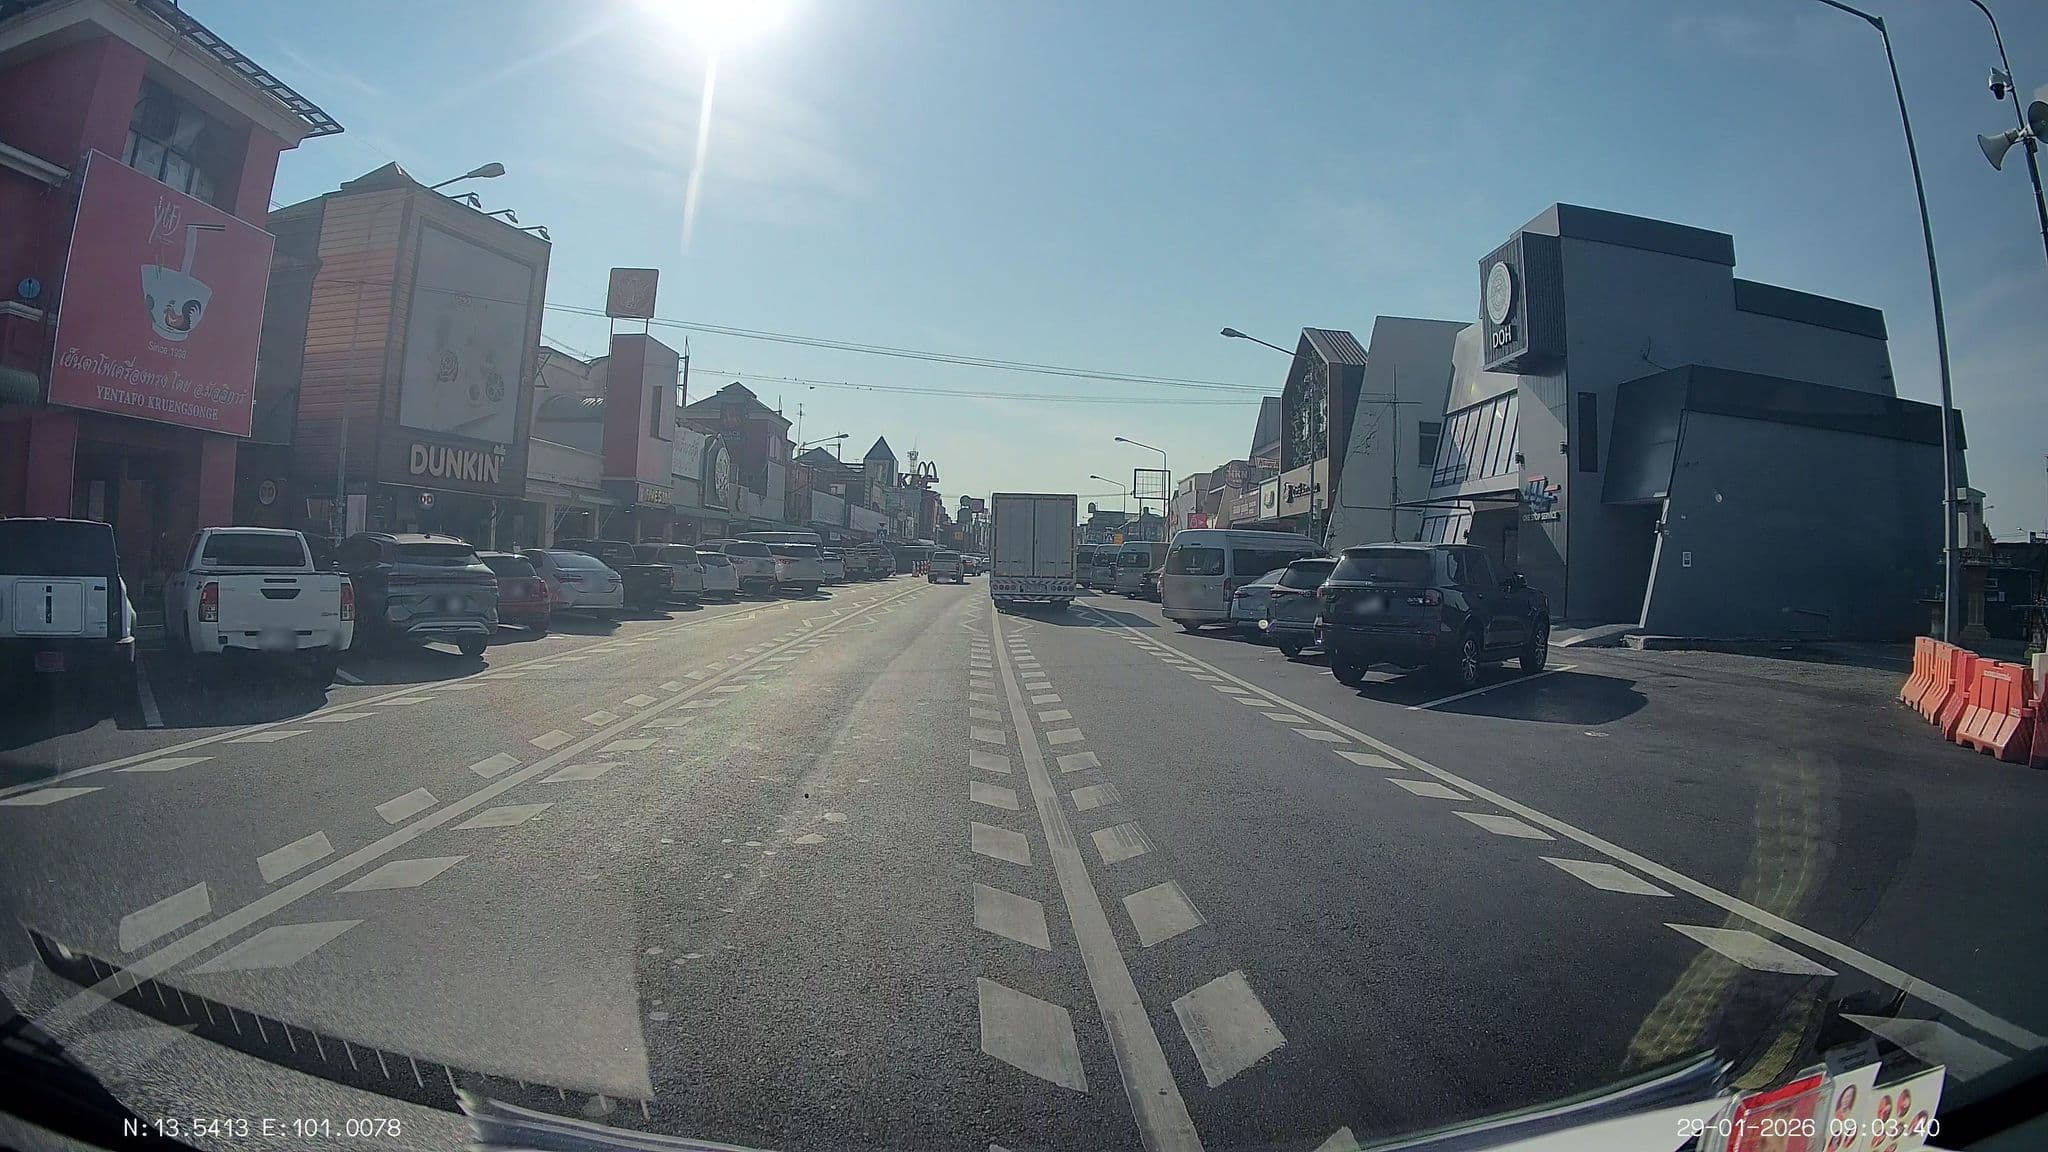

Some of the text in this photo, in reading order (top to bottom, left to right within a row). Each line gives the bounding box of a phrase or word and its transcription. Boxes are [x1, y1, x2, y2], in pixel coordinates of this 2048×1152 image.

[147, 340, 168, 355] Since
[1492, 325, 1512, 348] DOH
[96, 385, 219, 421] YENTAFO KRUENGSONGE
